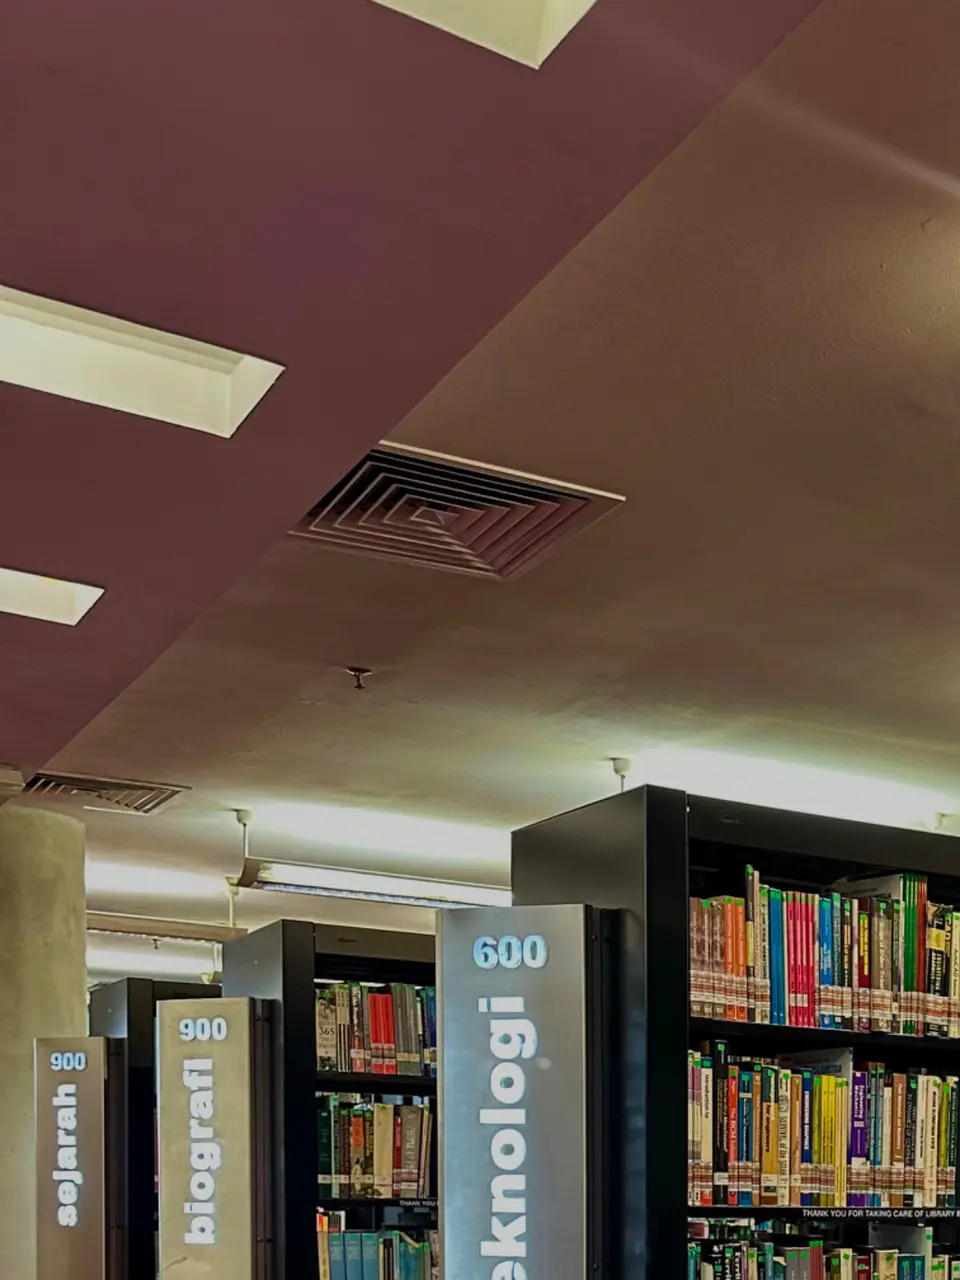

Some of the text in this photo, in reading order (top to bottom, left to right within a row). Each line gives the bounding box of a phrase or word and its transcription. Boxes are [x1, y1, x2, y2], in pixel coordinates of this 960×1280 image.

[473, 935, 547, 969] 600
[179, 1017, 227, 1042] 900
[50, 1052, 86, 1071] 900
[53, 1084, 83, 1227] sejarah
[184, 1058, 221, 1244] biografi
[803, 1209, 829, 1218] THANK
[831, 1209, 847, 1218] YOU
[848, 1209, 865, 1218] FOR
[866, 1209, 892, 1218] TAKING
[894, 1209, 914, 1218] CARE
[915, 1209, 925, 1218] OF
[926, 1209, 956, 1218] LIBRARY
